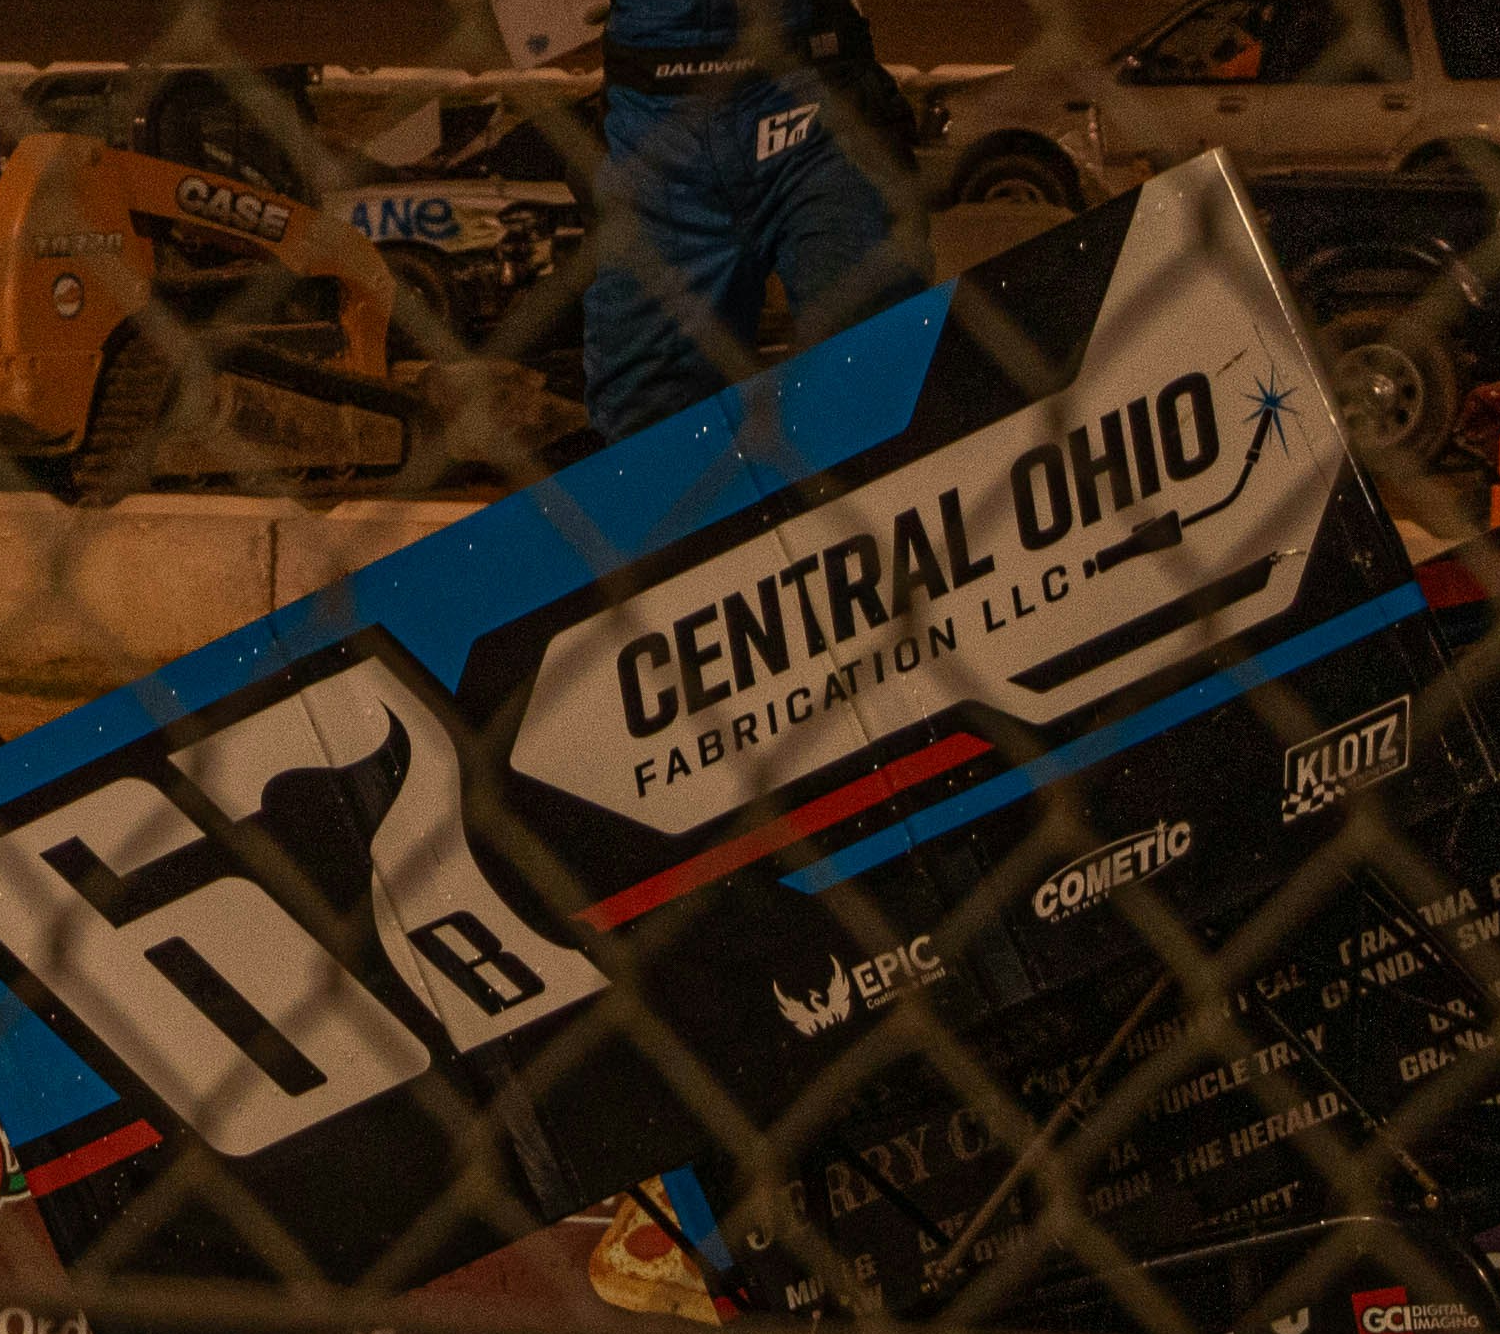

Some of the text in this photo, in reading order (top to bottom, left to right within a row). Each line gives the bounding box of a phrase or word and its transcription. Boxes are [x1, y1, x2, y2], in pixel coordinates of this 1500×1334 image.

[177, 175, 290, 242] CASE
[616, 370, 1222, 739] CENTRAL OHIO
[633, 565, 1071, 798] FABRICATION LLC
[1294, 714, 1402, 794] KLOTZ
[1031, 820, 1192, 921] COMETIC
[407, 910, 546, 1017] B
[851, 934, 943, 999] EPIC
[1254, 1022, 1327, 1076] TRY
[1362, 1302, 1468, 1334] GCI DIGITAL
[1412, 1315, 1481, 1332] IMAGING
